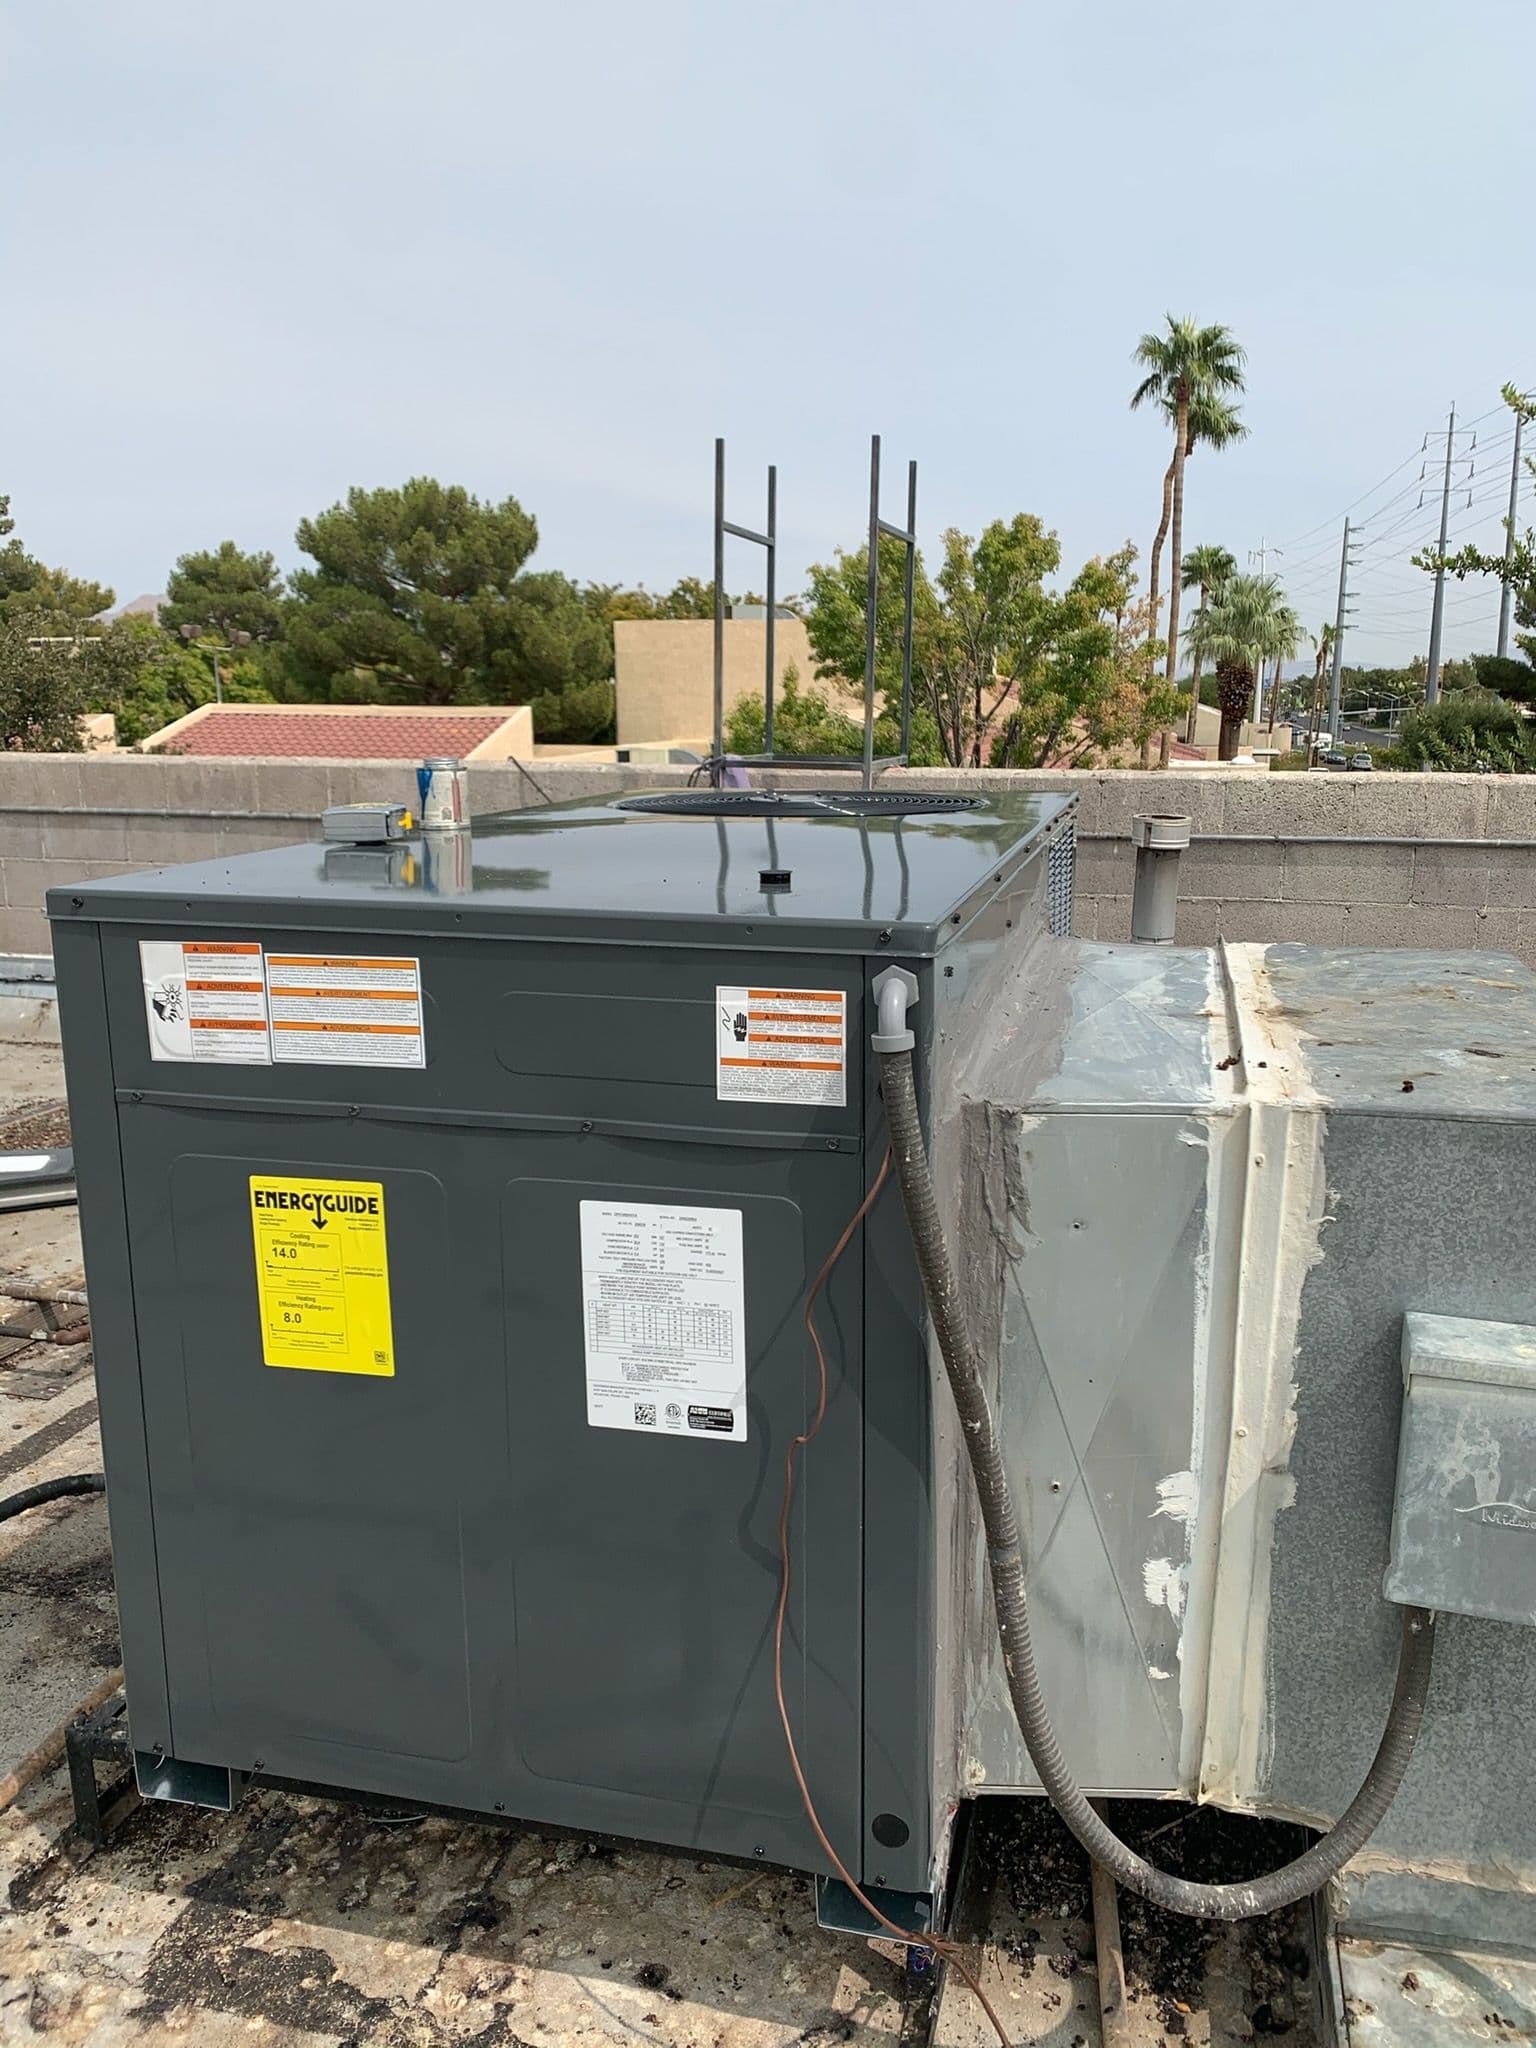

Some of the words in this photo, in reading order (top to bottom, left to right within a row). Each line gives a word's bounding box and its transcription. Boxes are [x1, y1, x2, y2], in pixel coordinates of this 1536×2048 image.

[206, 945, 237, 953] WARNING
[782, 991, 816, 1000] WARNING
[768, 1060, 801, 1068] WARNING
[254, 1190, 379, 1215] ENERGYGUIDE
[289, 1232, 311, 1241] Cooling
[271, 1239, 298, 1248] Efficiency
[298, 1240, 316, 1249] Rating
[271, 1247, 297, 1259] 14.0
[295, 1295, 317, 1303] Heating
[278, 1301, 304, 1310] Efficiency
[304, 1303, 322, 1311] Rating
[283, 1312, 302, 1324] 8.0
